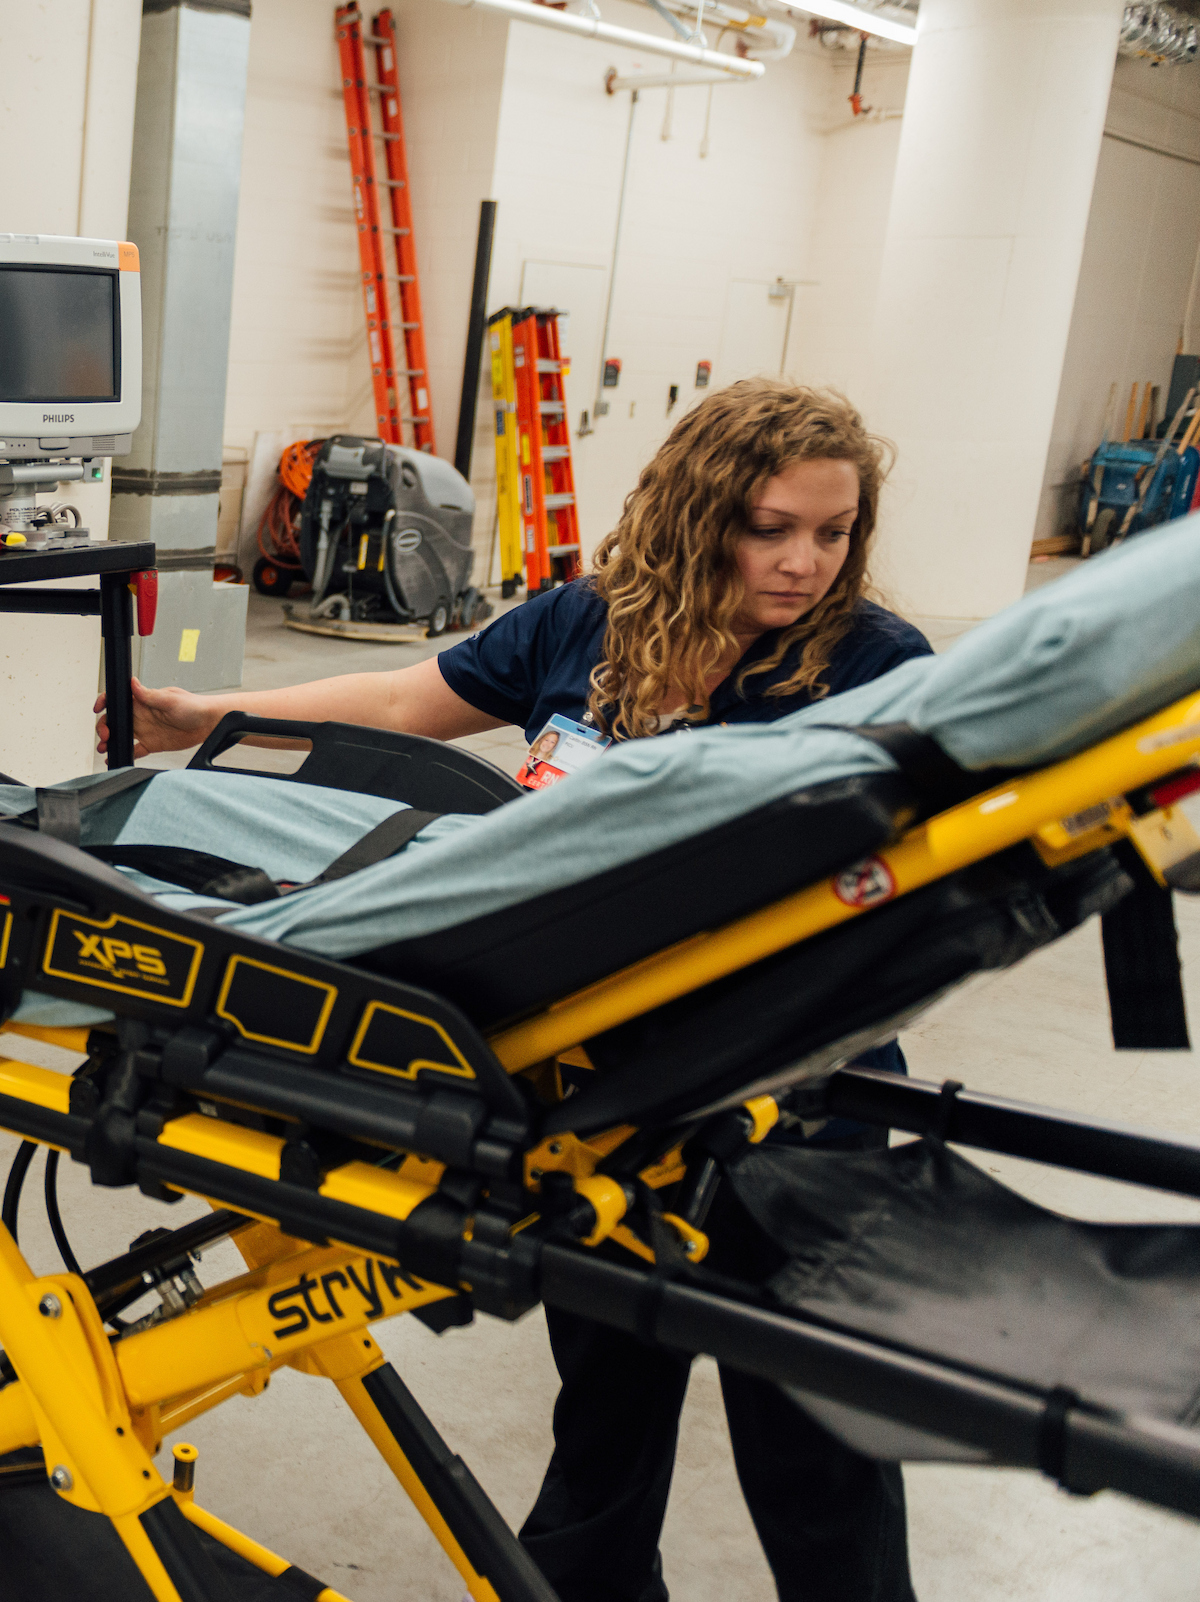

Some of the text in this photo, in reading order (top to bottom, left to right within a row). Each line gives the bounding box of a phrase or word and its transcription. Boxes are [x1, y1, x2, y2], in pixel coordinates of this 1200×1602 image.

[43, 414, 75, 423] PHILIPS
[542, 771, 560, 786] RN
[72, 930, 167, 978] XPS
